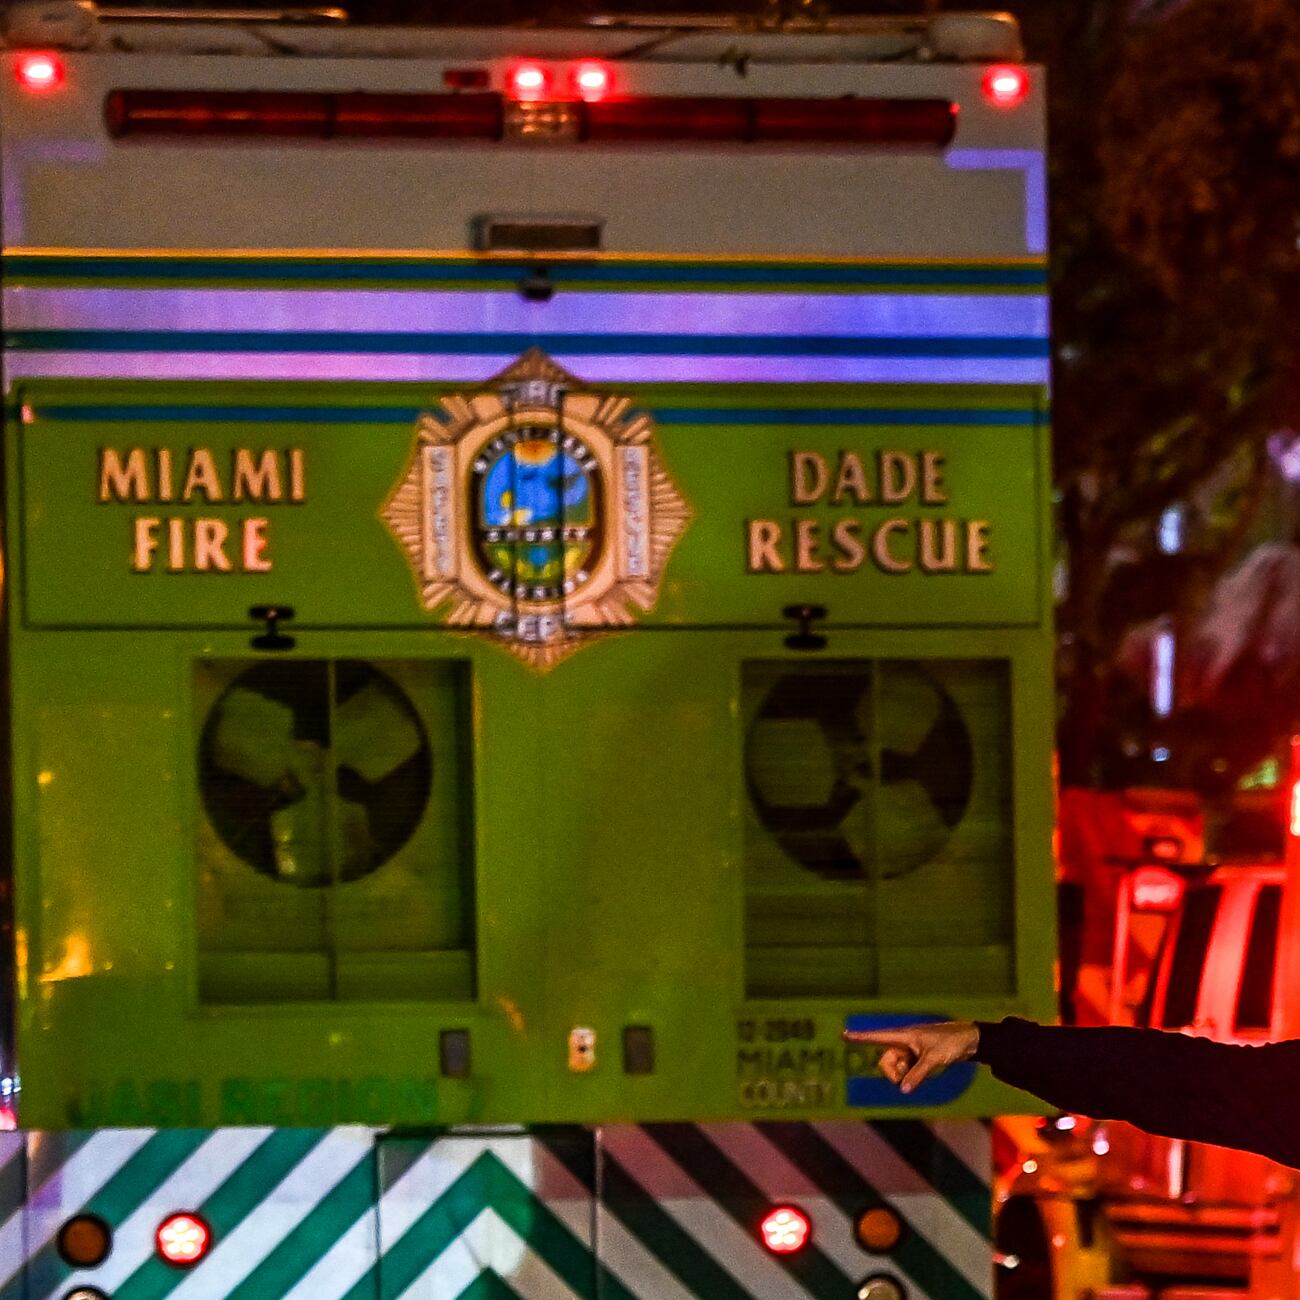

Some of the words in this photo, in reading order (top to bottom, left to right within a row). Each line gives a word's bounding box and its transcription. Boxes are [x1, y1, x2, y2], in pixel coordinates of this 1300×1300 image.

[99, 447, 305, 503] MIAMI
[791, 448, 950, 505] DADE
[133, 516, 274, 574] FIRE
[747, 516, 996, 575] RESCUE
[221, 1075, 440, 1123] REGION
